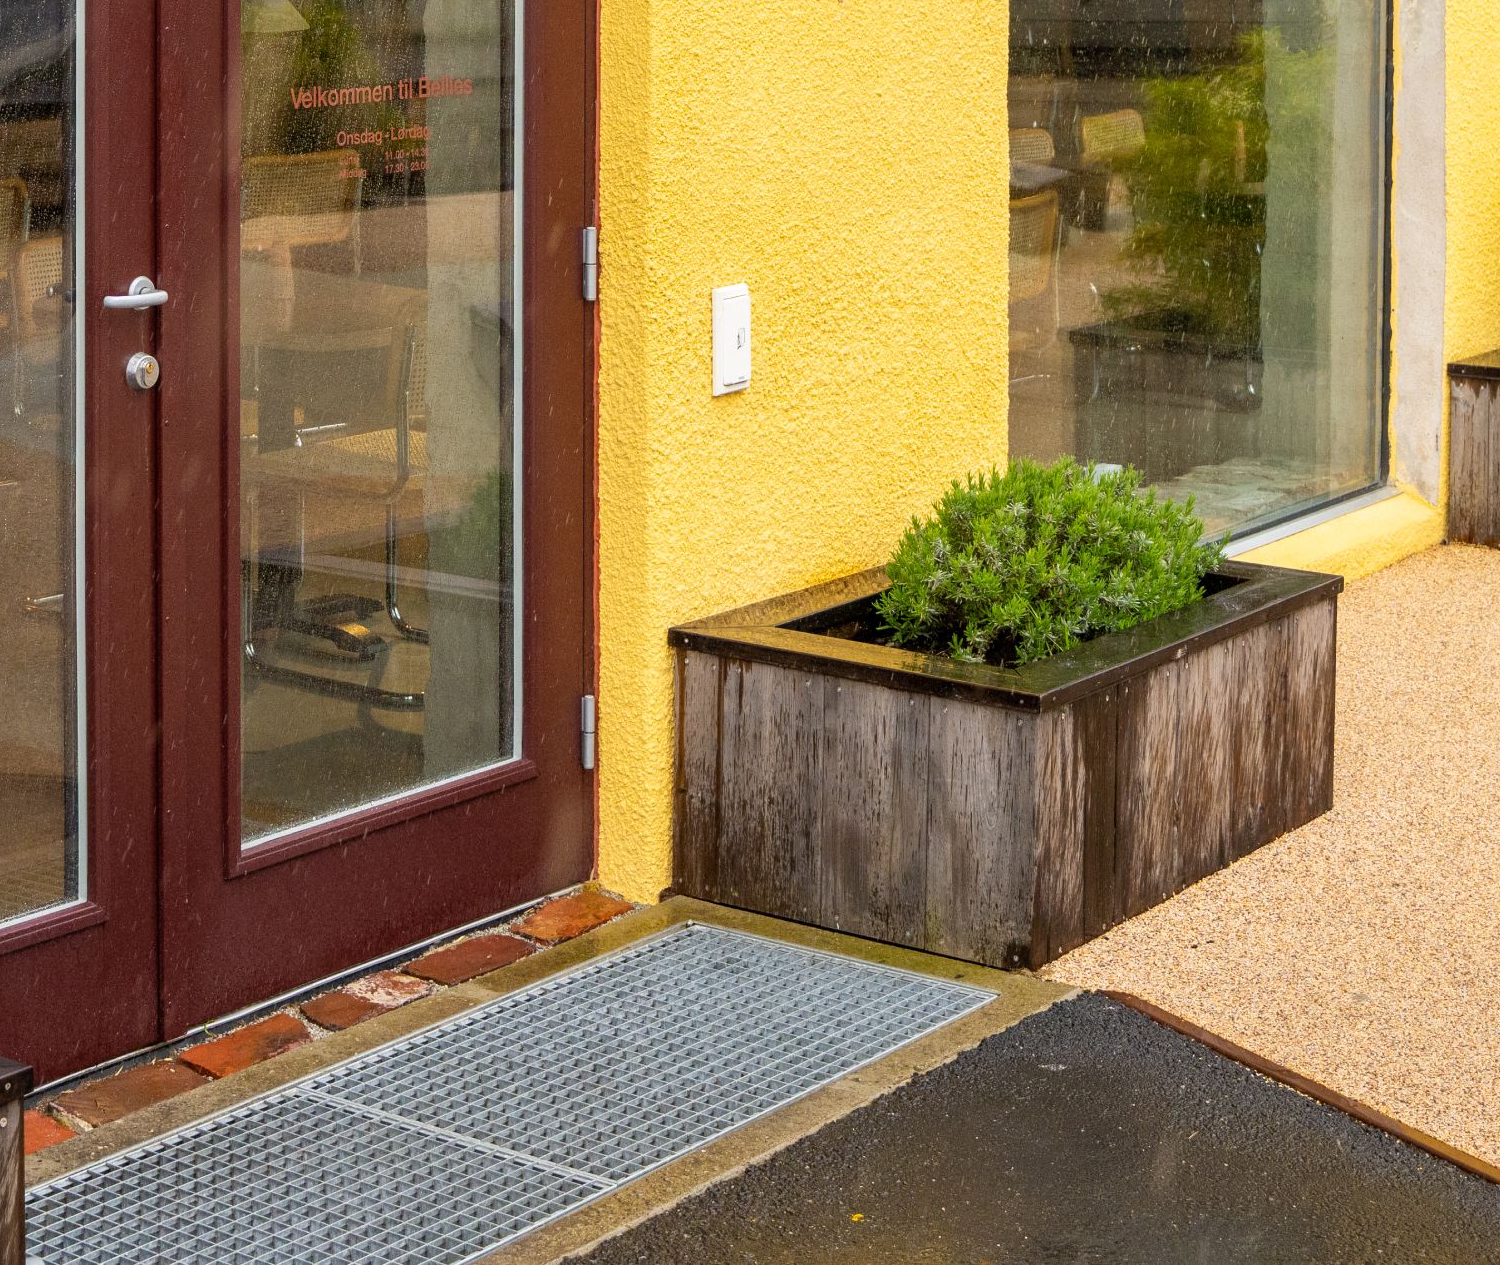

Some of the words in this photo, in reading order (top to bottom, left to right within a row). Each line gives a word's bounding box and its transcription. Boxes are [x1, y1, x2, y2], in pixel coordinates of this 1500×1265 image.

[290, 83, 394, 111] Velkommen
[398, 77, 413, 100] til
[418, 74, 473, 99] Bellies
[336, 128, 383, 147] Onsdag
